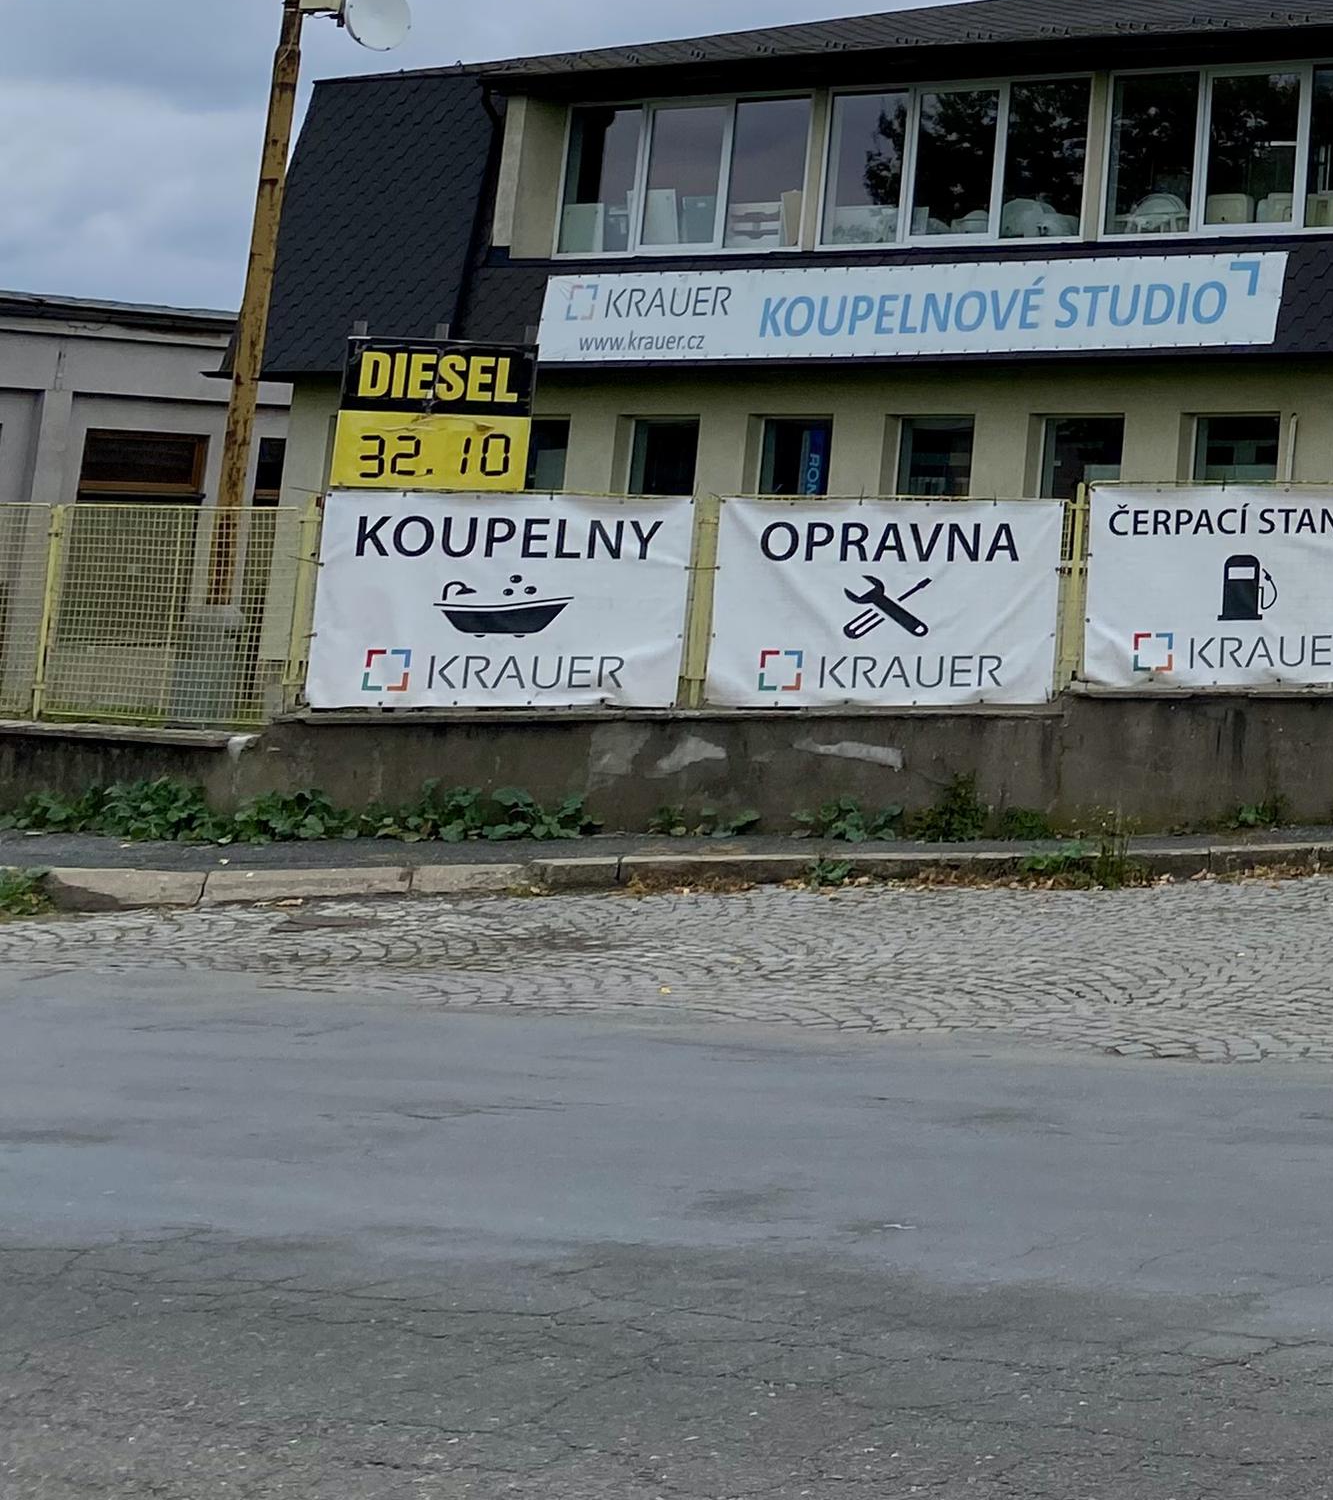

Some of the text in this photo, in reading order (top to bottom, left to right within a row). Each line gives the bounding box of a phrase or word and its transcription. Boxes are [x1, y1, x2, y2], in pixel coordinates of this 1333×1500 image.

[603, 276, 1228, 338] KRAUER KOUPELNOVÉ STUDIO
[579, 330, 705, 351] www.krauer.cz
[358, 351, 518, 403] DIESEL
[359, 433, 511, 478] 32.10
[355, 515, 664, 560] KOUPELNY
[1108, 503, 1250, 536] ČERPACÍ
[760, 521, 1020, 562] OPRAVNA
[426, 655, 626, 690] KRAUER
[818, 655, 1003, 689] KRAUER
